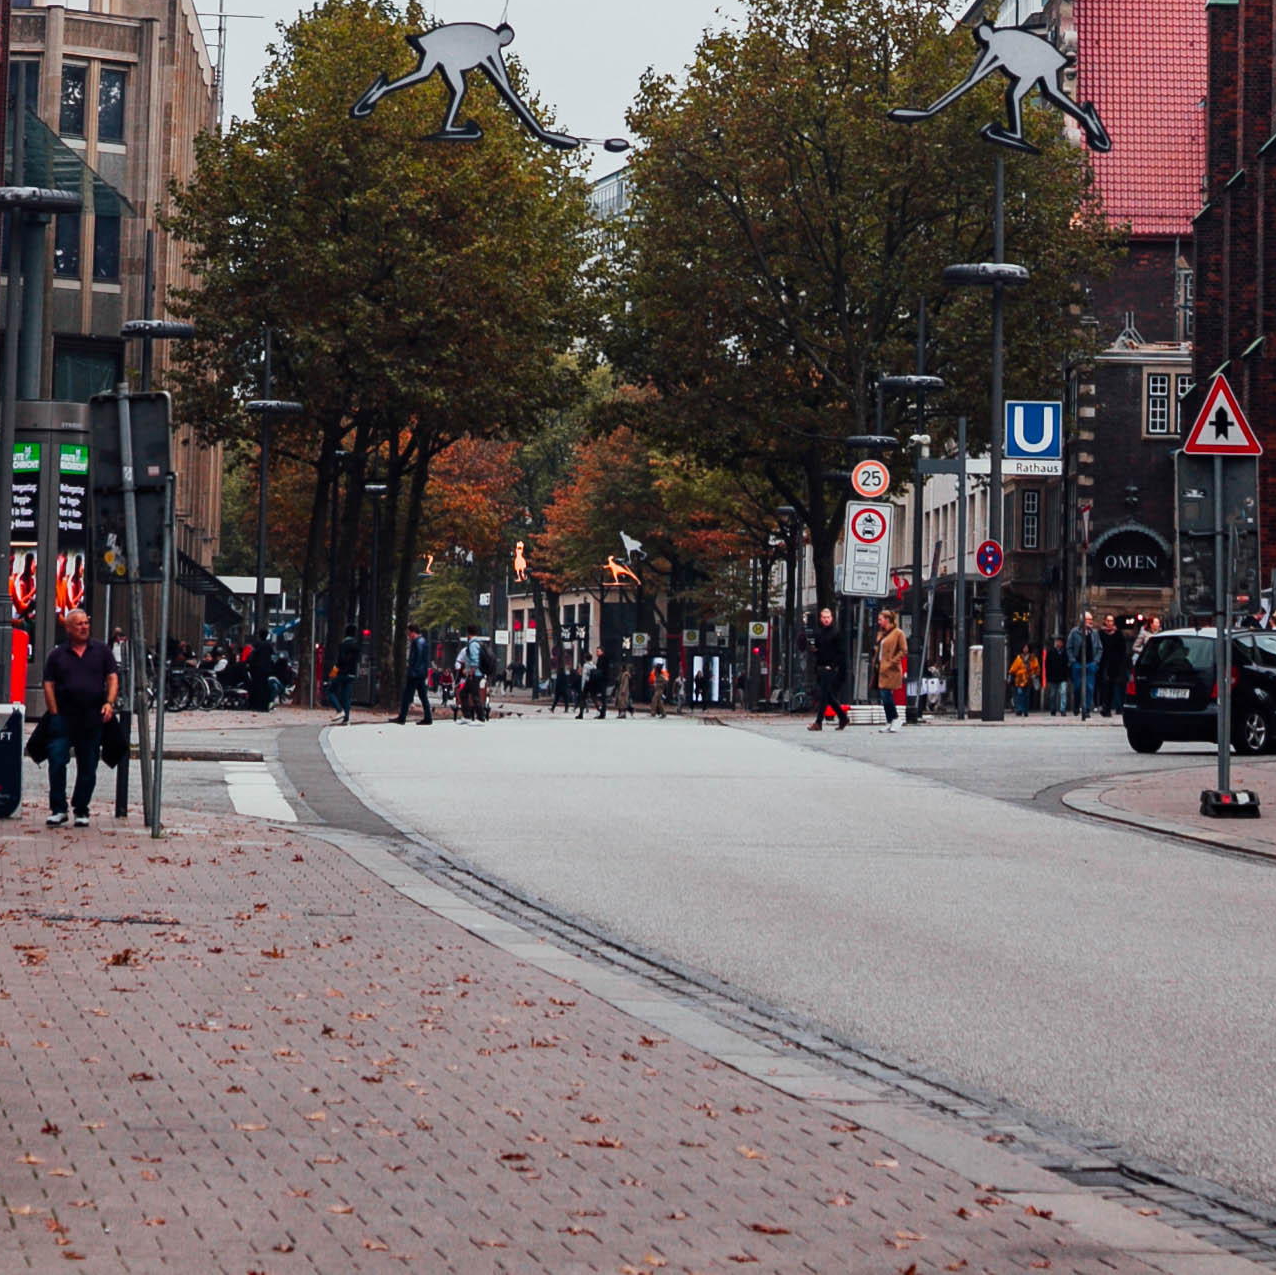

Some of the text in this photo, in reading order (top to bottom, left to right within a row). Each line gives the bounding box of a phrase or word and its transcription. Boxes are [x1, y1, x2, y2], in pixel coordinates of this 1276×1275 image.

[1014, 406, 1053, 453] U
[1016, 463, 1059, 473] Rathaus
[861, 470, 882, 487] 25
[1105, 555, 1157, 569] OMEN
